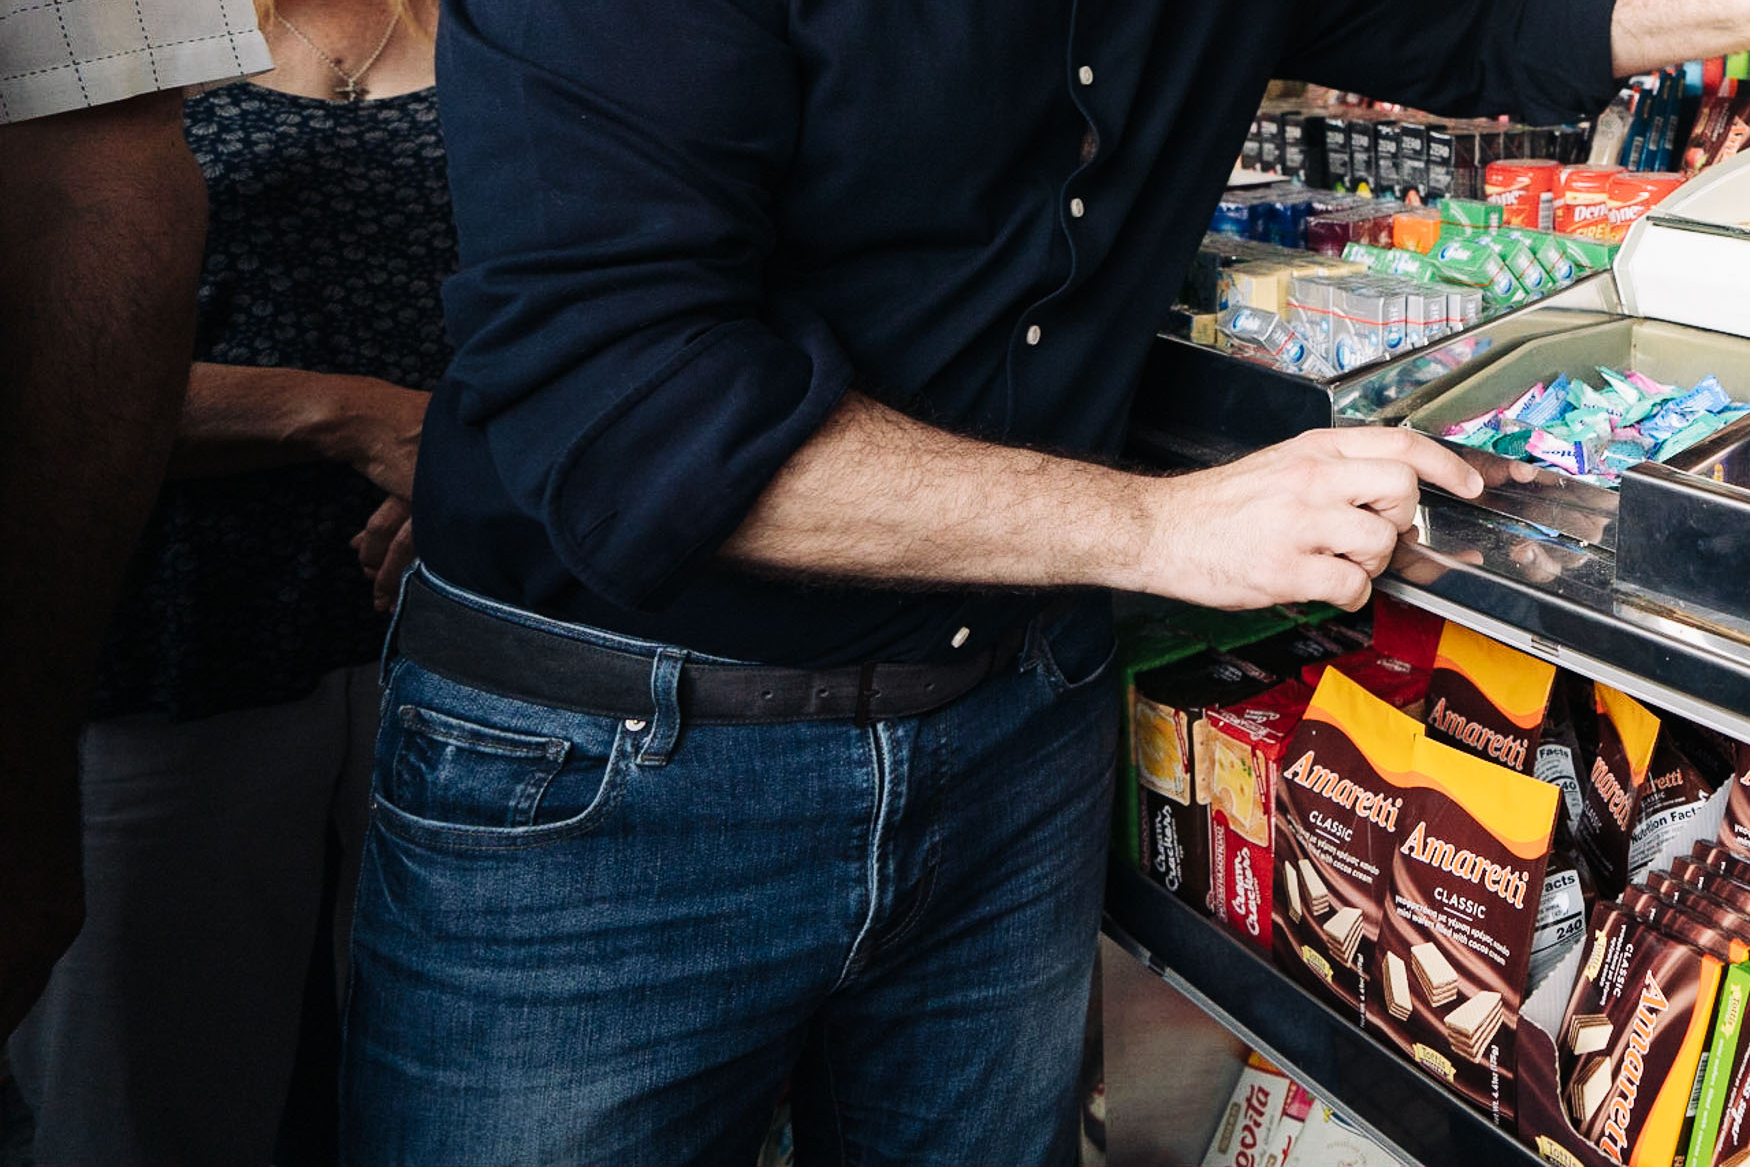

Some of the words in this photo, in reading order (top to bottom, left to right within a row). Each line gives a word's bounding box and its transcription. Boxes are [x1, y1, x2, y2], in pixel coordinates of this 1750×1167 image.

[1428, 697, 1528, 771] Amaretti
[1538, 747, 1569, 759] Facts
[1282, 749, 1404, 833] Amaretti
[1591, 756, 1633, 831] maretti
[1308, 810, 1354, 842] CLASSIC
[1244, 846, 1259, 937] Crackers
[1400, 821, 1530, 910] Amaretti
[1544, 873, 1576, 891] acts
[1434, 886, 1487, 919] CLASSIC
[1556, 919, 1583, 940] 240
[1613, 944, 1634, 998] CLASSIC
